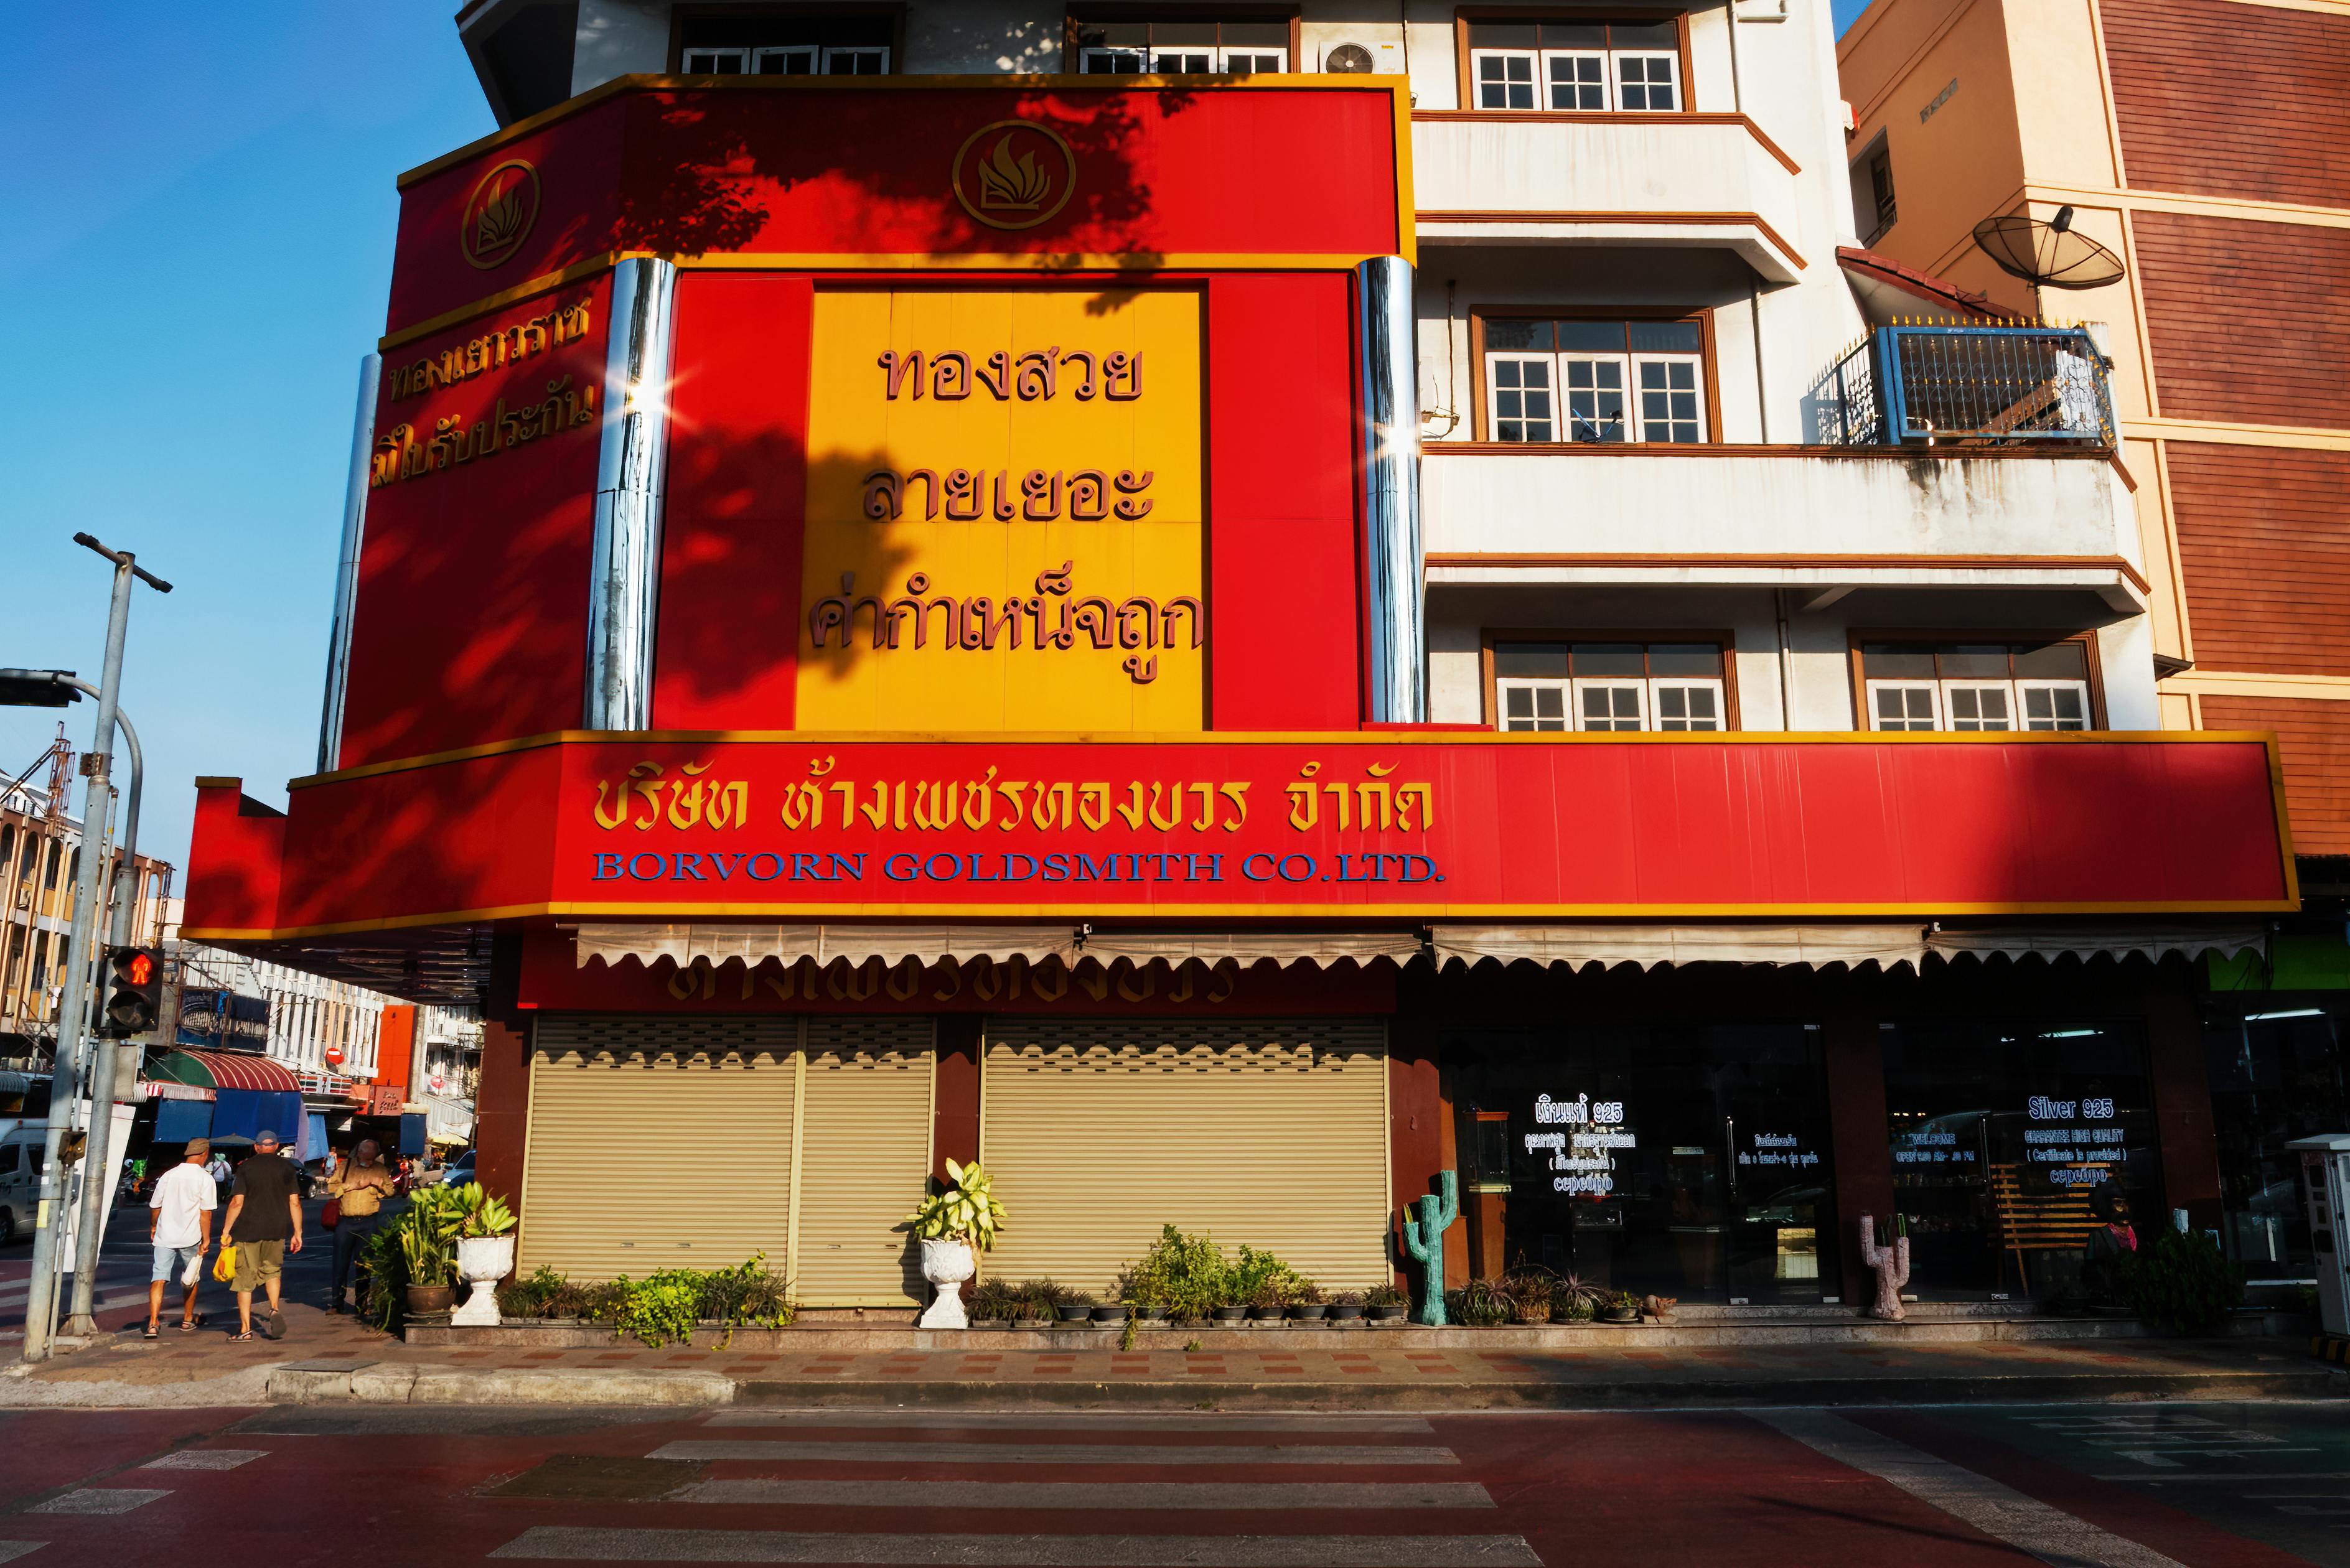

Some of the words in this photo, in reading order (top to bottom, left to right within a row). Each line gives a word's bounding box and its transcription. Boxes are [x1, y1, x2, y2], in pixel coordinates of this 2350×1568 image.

[388, 297, 592, 403] ทองเยาวราช
[877, 346, 1143, 401] ทองสวย
[371, 374, 595, 488] มีใบรับประกัน
[863, 469, 1154, 521] ลายเยอะ
[809, 560, 1204, 684] ค่ากำเหน็จถูก
[593, 756, 749, 831] บริษัท
[781, 755, 1252, 833] ห้างเพชรทองบวร
[1285, 760, 1434, 833] จำกัด
[591, 852, 869, 882] BORVORN
[884, 852, 1224, 882] GOLDSMITH
[1534, 1093, 1588, 1124] เงินแท้
[1592, 1102, 1624, 1124] 925
[2028, 1095, 2076, 1119] Silver
[2082, 1098, 2115, 1119] 925
[1911, 1133, 1956, 1146] WELCOME
[2092, 1129, 2125, 1143] QUALITY
